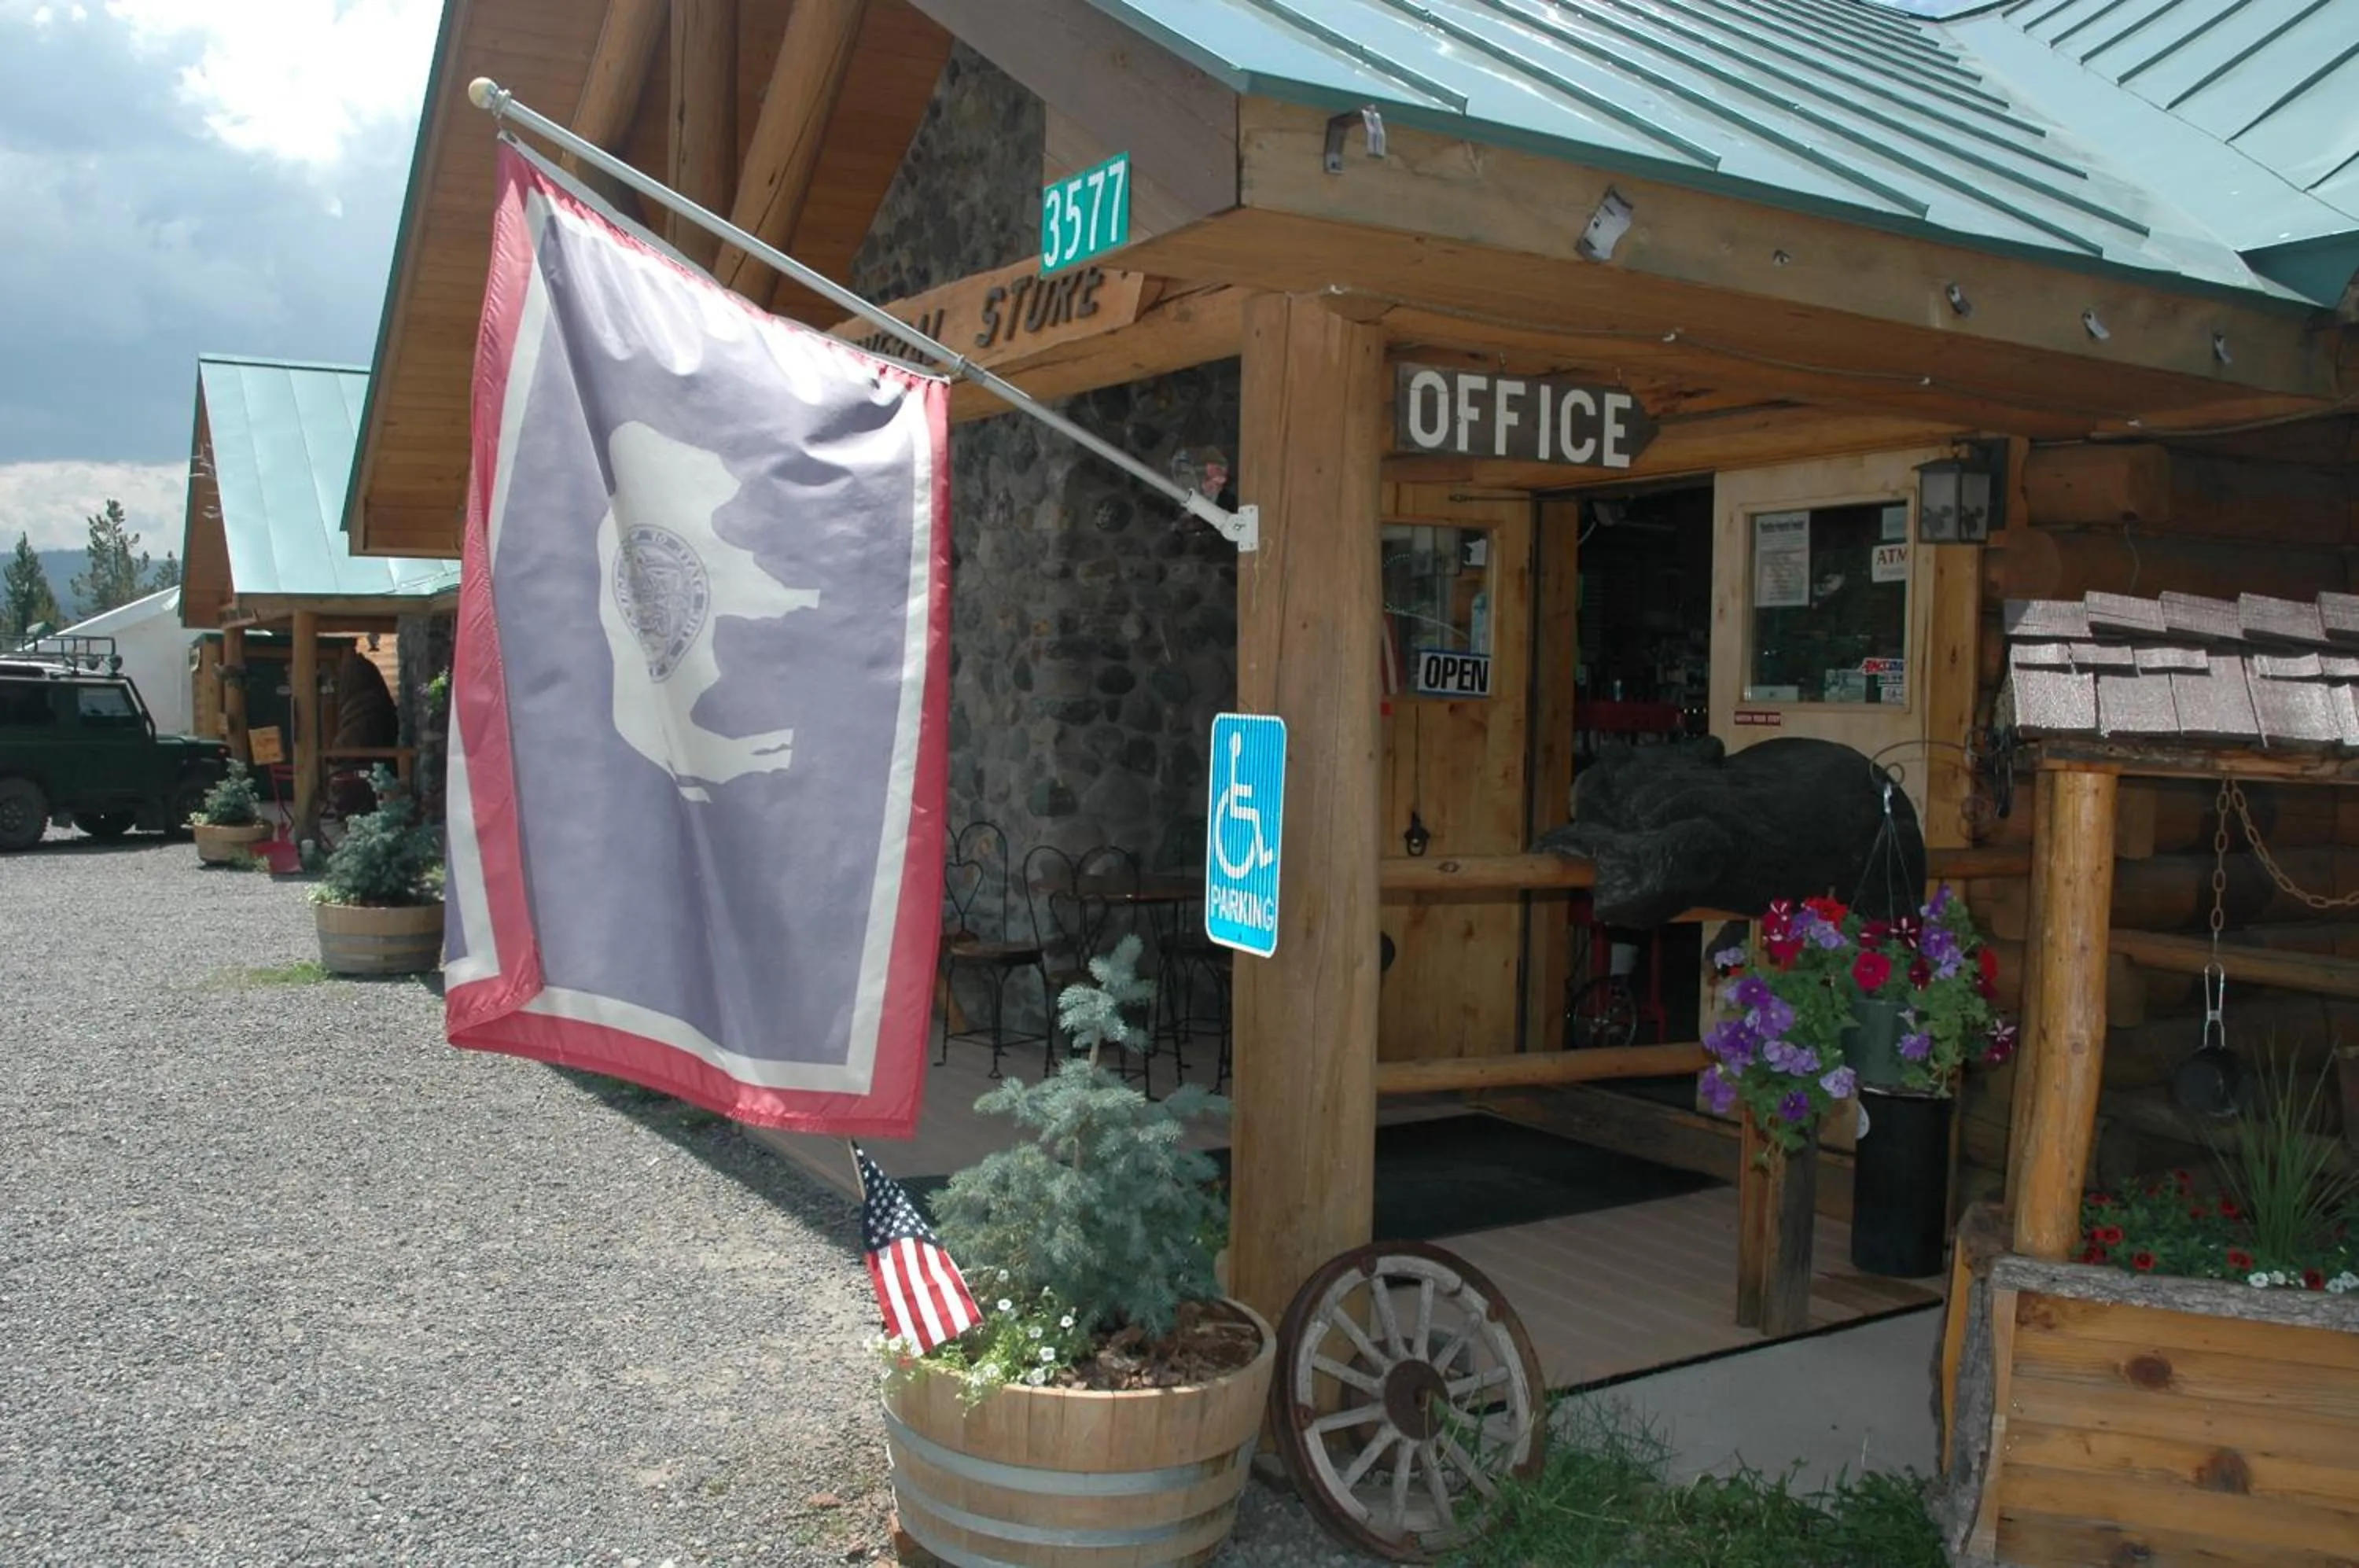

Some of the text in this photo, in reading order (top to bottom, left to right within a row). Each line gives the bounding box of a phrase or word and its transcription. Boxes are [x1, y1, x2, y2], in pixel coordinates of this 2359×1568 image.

[1043, 159, 1125, 268] 3577
[975, 266, 1105, 348] STORE
[1408, 370, 1632, 468] OFFICE
[1876, 547, 1908, 565] ATM
[1424, 655, 1490, 693] OPEN
[1210, 885, 1275, 932] PARKING
